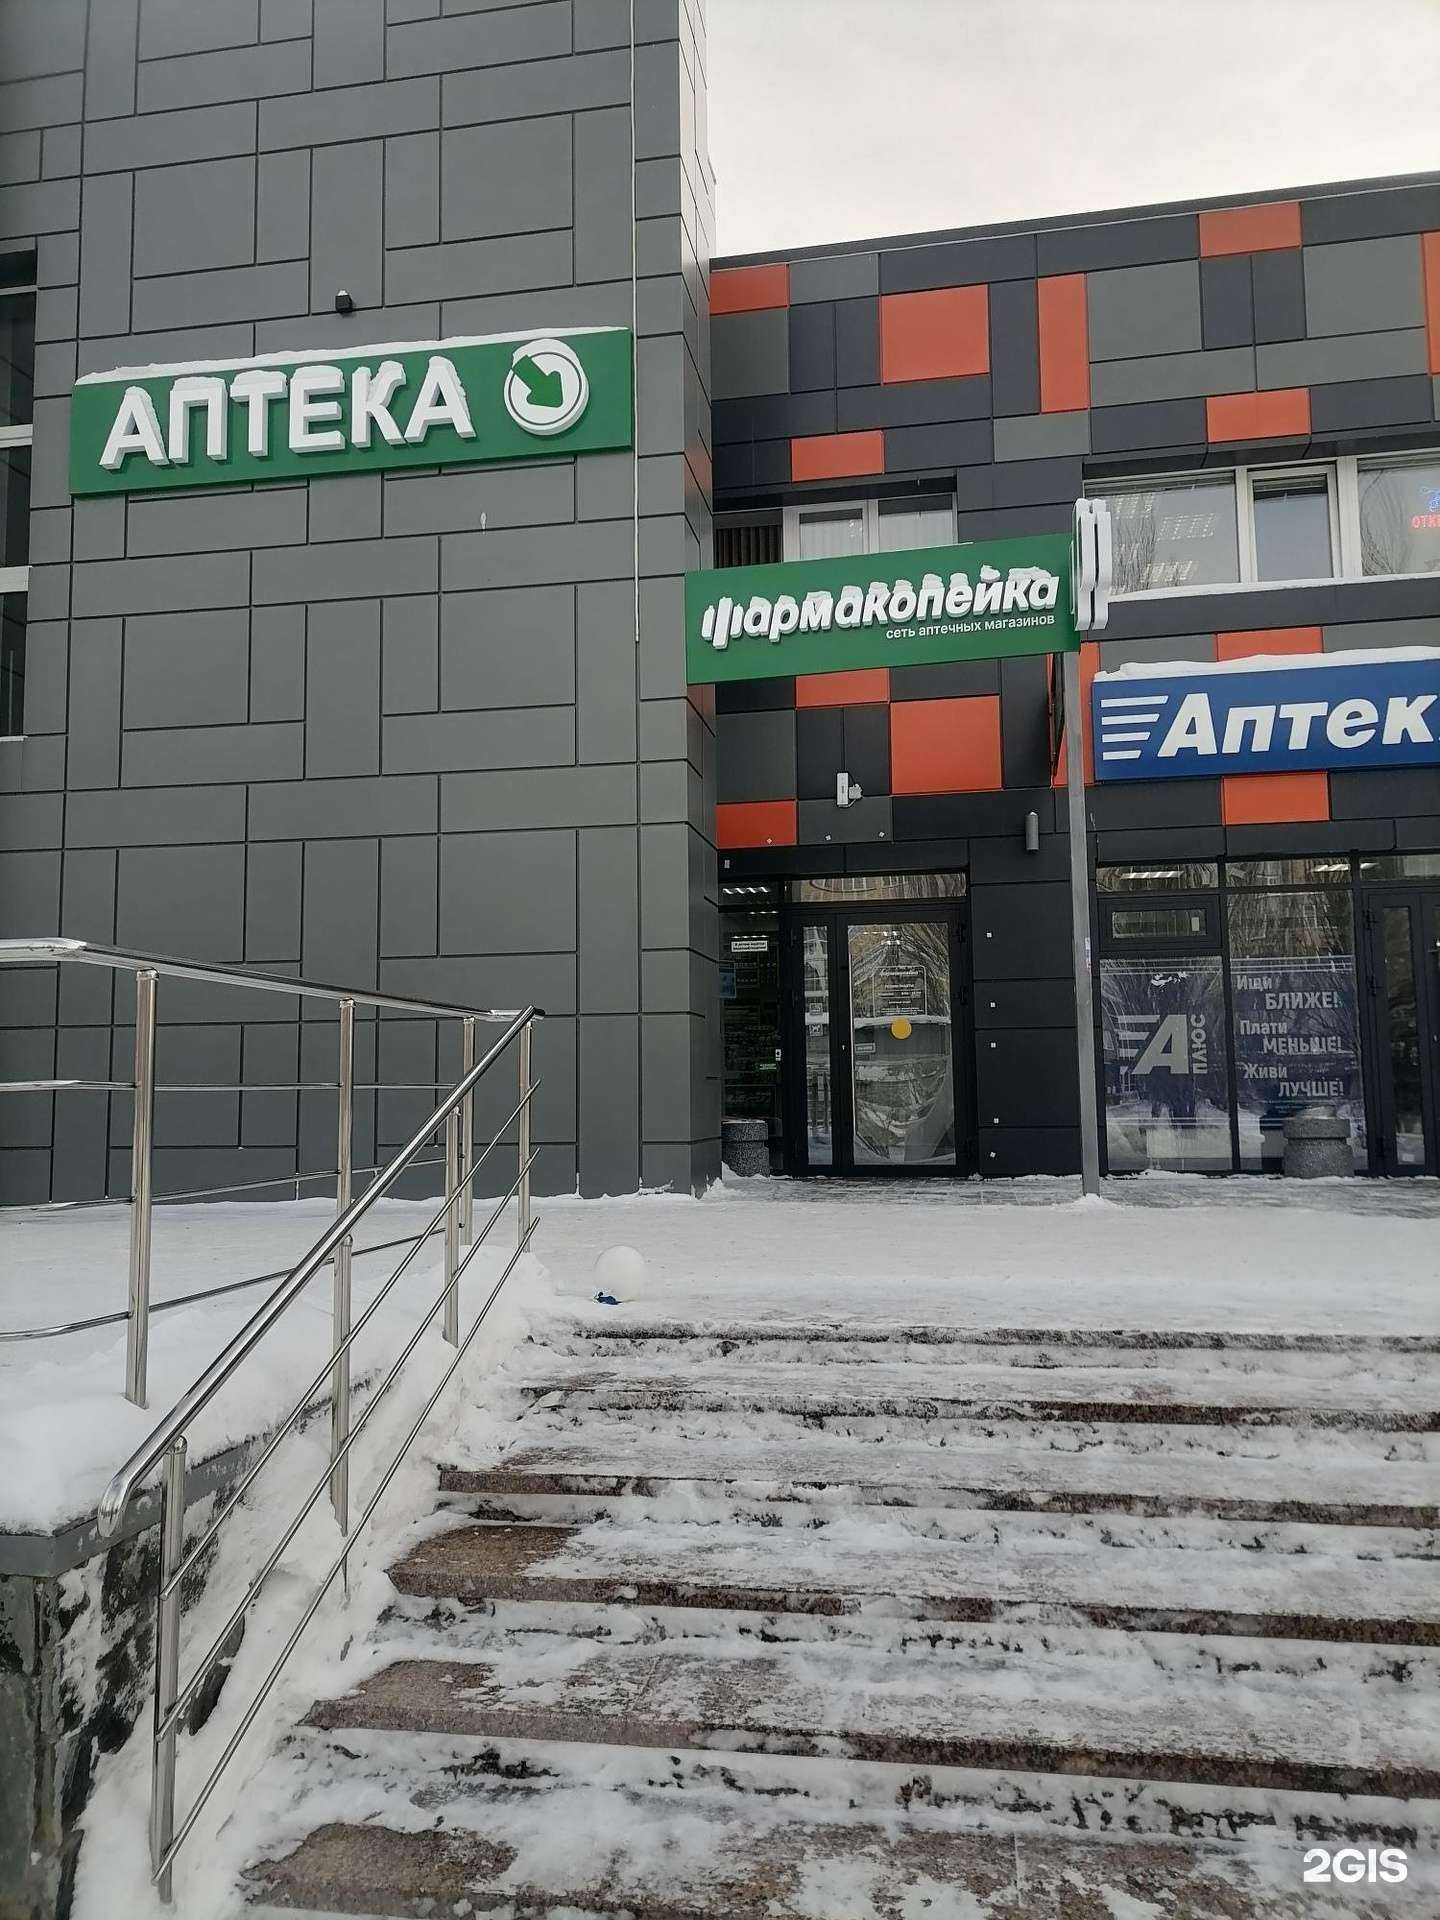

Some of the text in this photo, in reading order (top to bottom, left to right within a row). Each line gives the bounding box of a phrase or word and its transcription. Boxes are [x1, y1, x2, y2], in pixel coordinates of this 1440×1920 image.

[98, 355, 477, 471] АПТЕКА
[1412, 514, 1440, 529] ОТК
[701, 564, 1060, 649] Фармакопейка
[886, 614, 1055, 639] сеть аптечных магазинов
[1157, 692, 1440, 758] Аптек
[1236, 974, 1273, 992] Ищи
[1264, 990, 1343, 1010] БЛИЖЕ!
[1239, 1019, 1288, 1036] Плати
[1190, 1013, 1208, 1074] ПЛЮС
[1262, 1035, 1342, 1054] МЕНЬШЕ!
[1243, 1062, 1288, 1079] Живи
[1278, 1080, 1344, 1098] ЛУЧШЕ!
